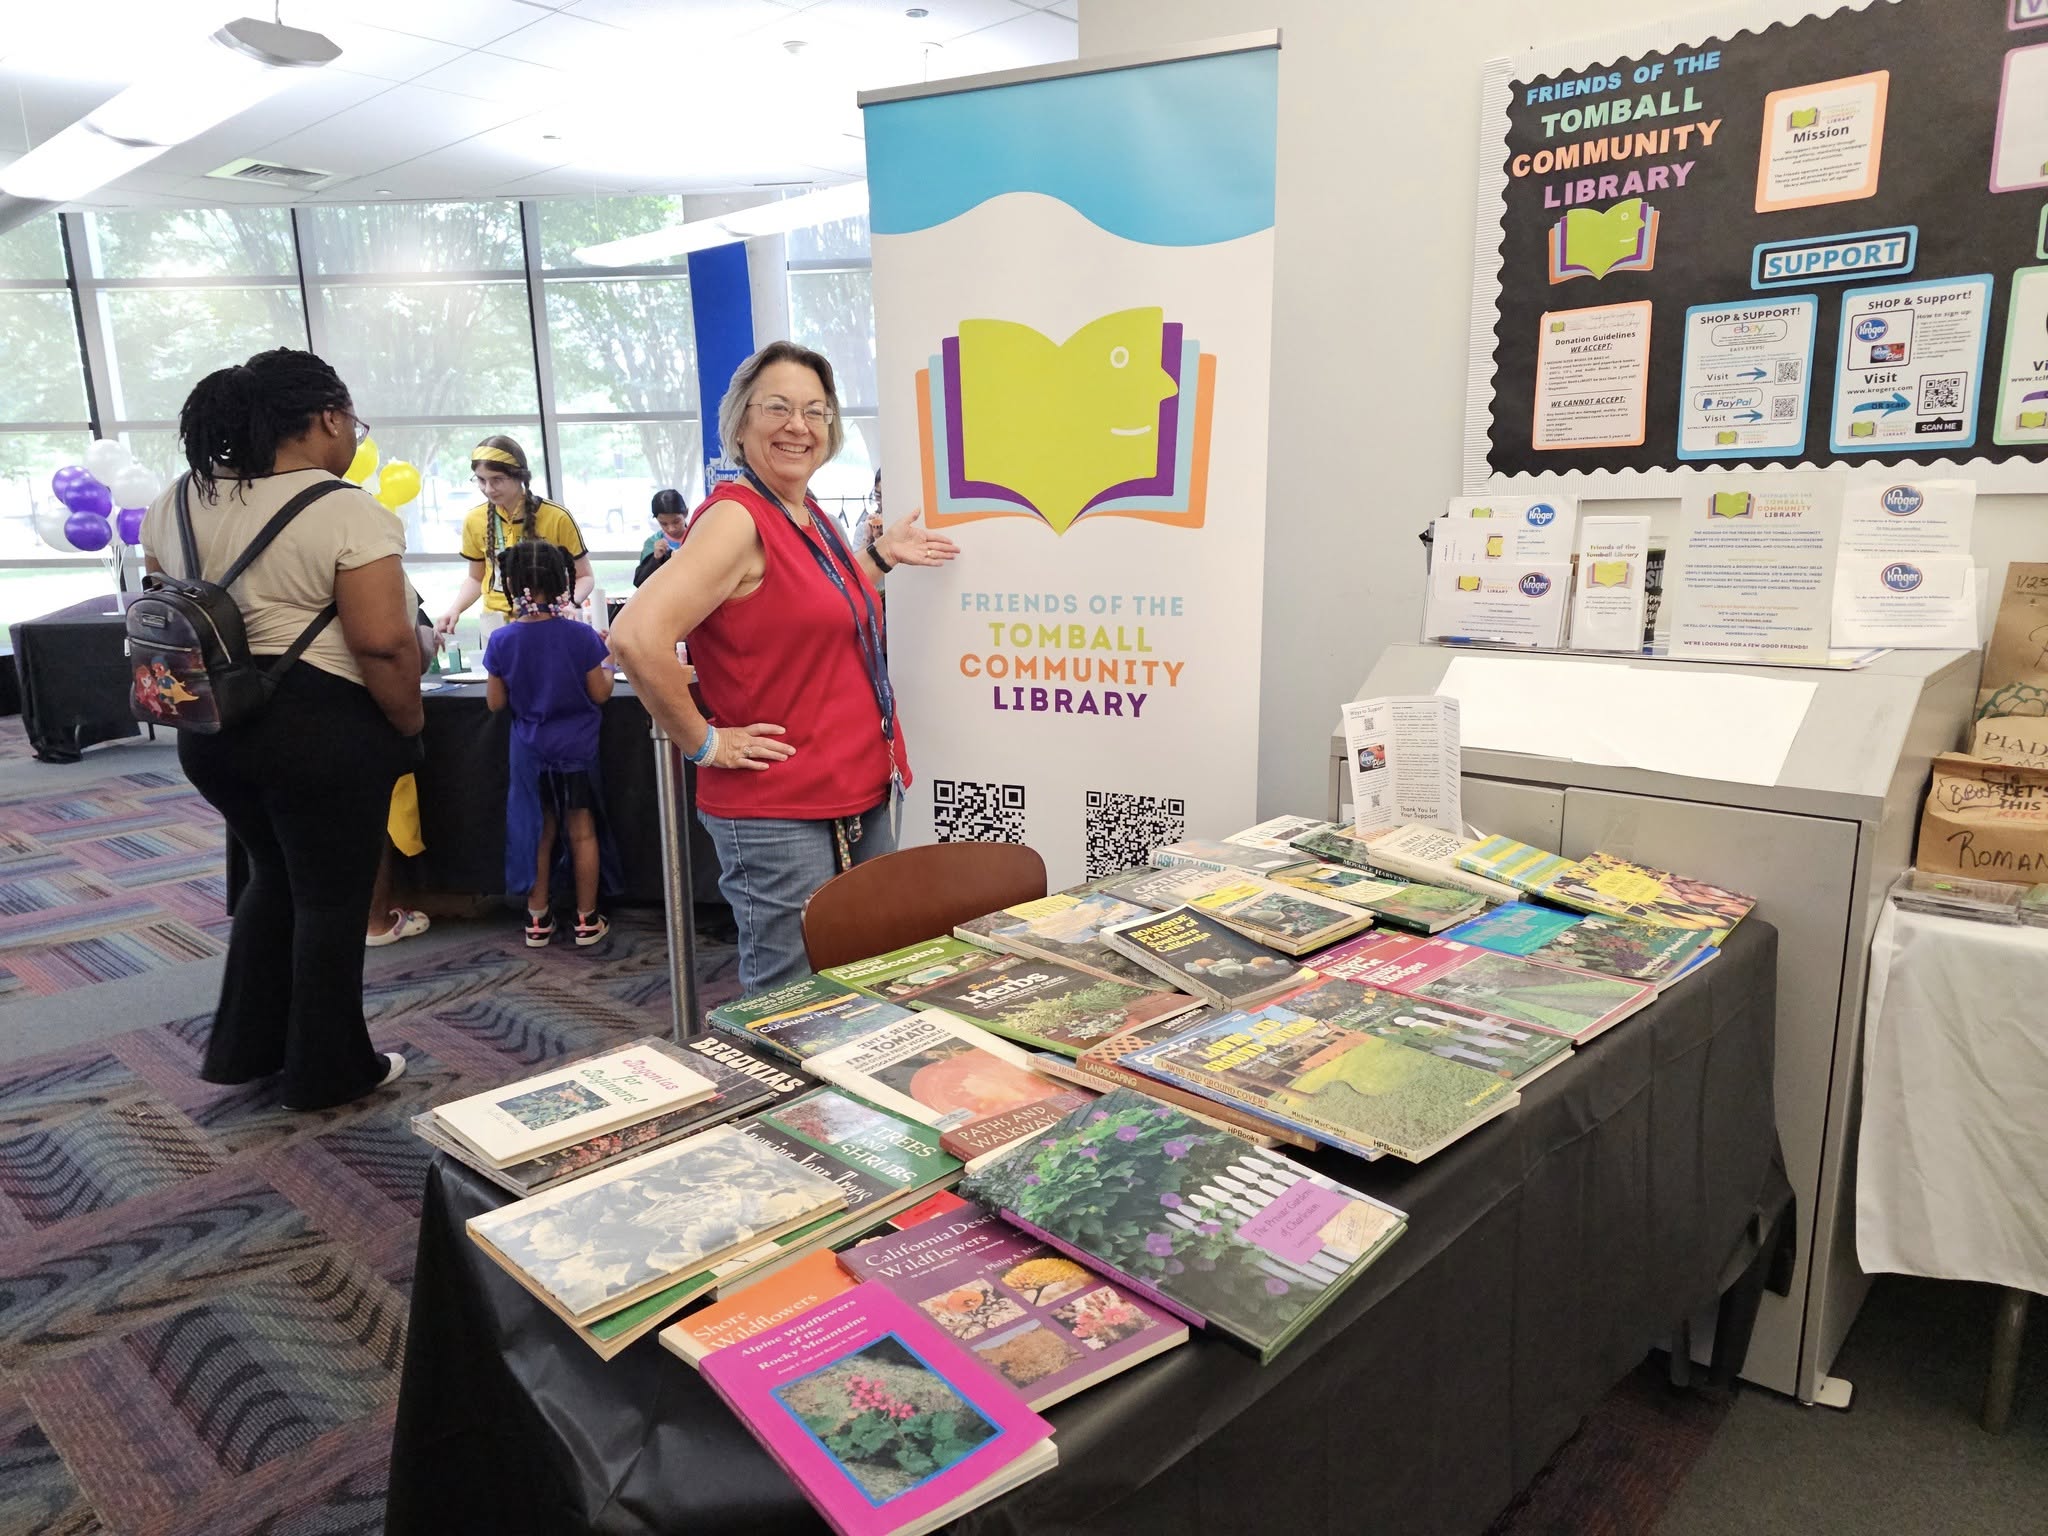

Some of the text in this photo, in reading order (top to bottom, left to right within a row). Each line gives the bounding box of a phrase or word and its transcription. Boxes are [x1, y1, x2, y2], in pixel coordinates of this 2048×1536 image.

[1527, 51, 1721, 106] FRIENDS OF THE
[1541, 87, 1703, 138] TOMBALL
[1793, 126, 1849, 143] Mission
[1512, 119, 1722, 177] COMMUNITY
[1544, 161, 1696, 208] LIBRARY
[1768, 241, 1900, 276] SUPPORT
[1868, 291, 1972, 310] SHOP & Support!
[1701, 314, 1730, 324] SHOP
[1743, 307, 1800, 320] SUPPORT!
[1555, 331, 1636, 345] Donation Guidelines
[1734, 323, 1765, 334] ebay
[1859, 322, 1886, 339] Kroger
[1570, 342, 1613, 353] WE ACCEPT:
[1707, 372, 1728, 381] Visit
[1865, 372, 1897, 385] Visit
[1564, 398, 1594, 407] CANNOT
[1596, 395, 1626, 404] ACCEPT:
[1847, 385, 1913, 395] www.krogers.com
[1716, 399, 1752, 408] PayPal
[1705, 414, 1726, 422] Visit
[1887, 489, 1919, 511] Kroger
[1528, 507, 1554, 525] Kroger
[1523, 577, 1548, 594] Kroger
[1887, 567, 1918, 588] Kroger
[961, 592, 1184, 617] FRIENDS OF THE
[988, 622, 1153, 652] TOMBALL
[960, 653, 1185, 687] COMMUNITY
[993, 686, 1147, 718] LIBRARY
[2000, 798, 2041, 810] THIS
[1157, 854, 1175, 868] ASK
[1128, 914, 1191, 939] ROADSIDE
[1138, 919, 1199, 944] PLANTS of
[1146, 928, 1200, 948] Southern
[1155, 932, 1211, 953] California
[840, 947, 945, 980] Landscaping
[1384, 962, 1428, 983] Hedges
[955, 972, 1049, 1004] Herbs
[968, 974, 1009, 990] Sunset
[724, 980, 816, 1013] Container Gardening
[741, 986, 812, 1012] Indoors and Out
[760, 1003, 853, 1034] CULINARY HERBS
[870, 1024, 936, 1053] TOMATO
[1198, 1032, 1253, 1059] LAWNS
[1248, 1019, 1282, 1035] AND
[1202, 1043, 1267, 1072] GROUND
[1259, 1019, 1320, 1046] COVERS
[622, 1059, 680, 1091] Begonias
[689, 1036, 805, 1093] BEGONIAS
[1058, 1066, 1081, 1080] HOME
[1085, 1062, 1138, 1087] LANDSCAPING
[579, 1069, 649, 1104] Beginners!
[611, 1074, 643, 1086] for
[1161, 1062, 1269, 1107] LAWNS AND GROUND COVERS
[958, 1106, 1046, 1140] PATHS AND
[970, 1113, 1061, 1149] WALKWAYS
[1227, 1126, 1260, 1144] HPBooks
[1291, 1110, 1347, 1138] Michael MacCaskey
[855, 1137, 890, 1151] AND
[872, 1126, 938, 1158] TREES
[1373, 1138, 1408, 1158] HPBooks
[840, 1143, 918, 1184] SHRUBS
[833, 1170, 874, 1204] Trees
[1252, 1188, 1314, 1238] The Private Gardens
[1286, 1202, 1321, 1233] Charleston
[1281, 1227, 1292, 1238] of
[865, 1231, 951, 1268] California
[878, 1233, 990, 1279] Wildflowers
[986, 1250, 1023, 1272] Philip A.
[694, 1311, 749, 1341] Shore
[709, 1294, 819, 1349] Wildflowers
[741, 1299, 857, 1357] Alpine Wildflowers
[758, 1315, 867, 1371] Rocky Mountains
[789, 1327, 824, 1347] of the
